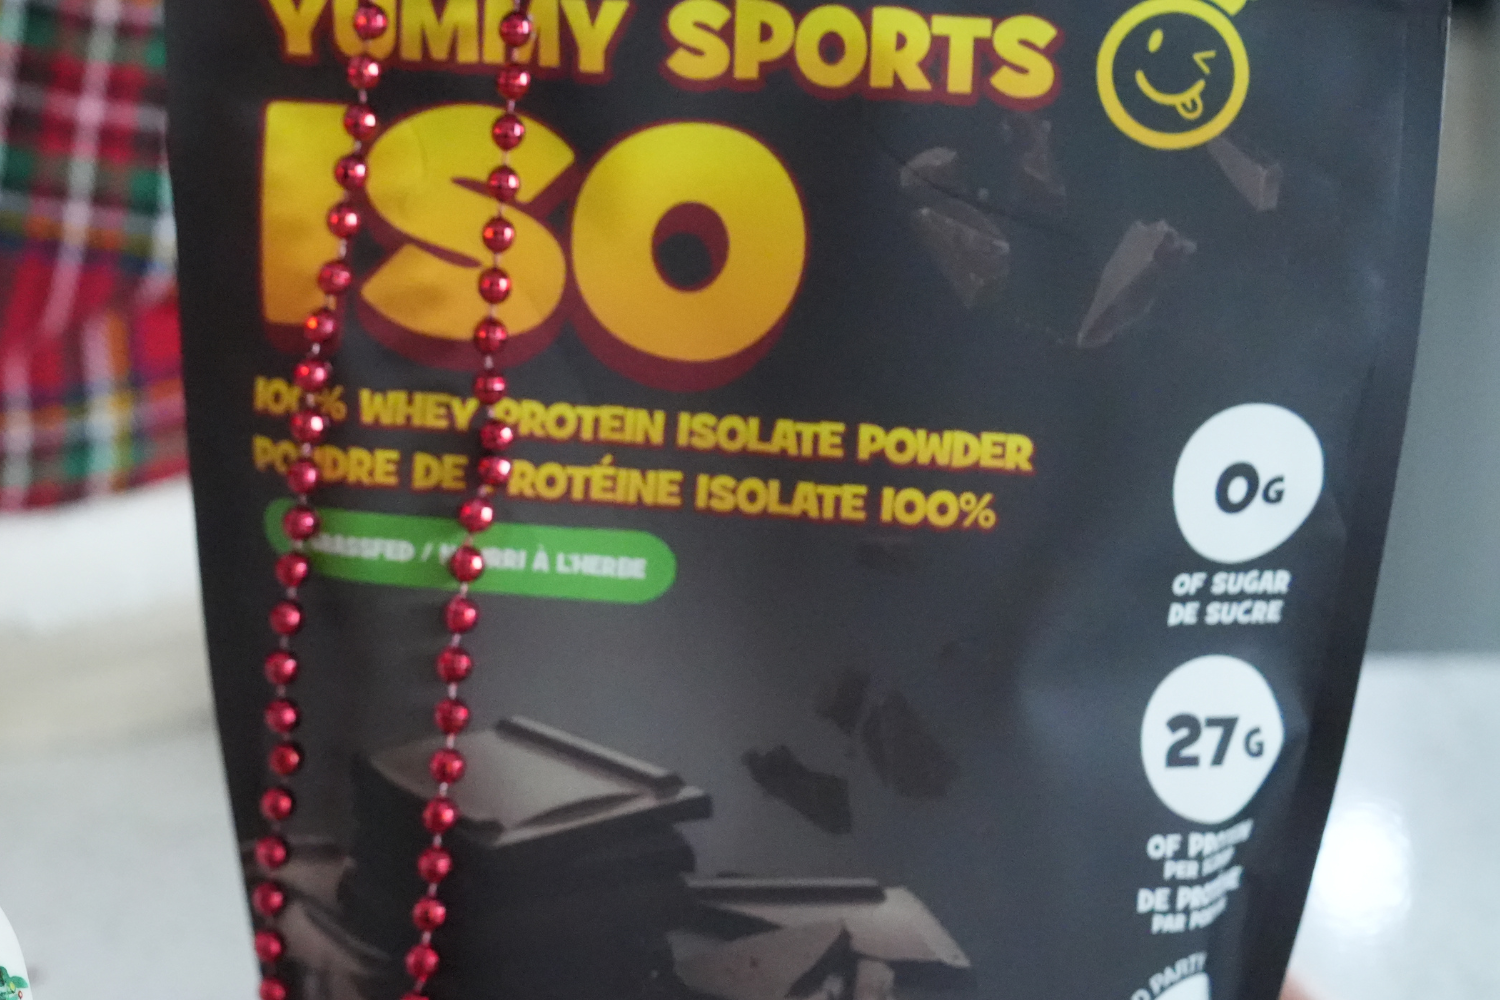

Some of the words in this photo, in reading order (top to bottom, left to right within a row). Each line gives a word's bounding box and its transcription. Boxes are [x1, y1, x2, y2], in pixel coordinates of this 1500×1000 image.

[268, 0, 632, 74] YUMMY
[664, 0, 1059, 99] SPORTS
[261, 99, 807, 366] ISO
[253, 375, 349, 422] 10%
[357, 387, 480, 432] WHEY
[675, 410, 847, 460] ISOLATE
[856, 421, 1036, 473] POWDER
[252, 434, 401, 488] PODRE
[411, 451, 470, 491] DE
[484, 453, 684, 508] ROTÉINE
[694, 473, 870, 522] ISOLATE
[880, 486, 998, 530] 100%
[1214, 460, 1286, 515] 0G
[531, 542, 550, 573] À
[1171, 571, 1207, 597] OF
[1210, 569, 1292, 596] SUGAR
[1166, 601, 1200, 628] DE
[1204, 599, 1285, 626] SUCRE
[1164, 712, 1266, 768] 27G
[1146, 833, 1183, 861] OF
[1136, 887, 1172, 915] DE
